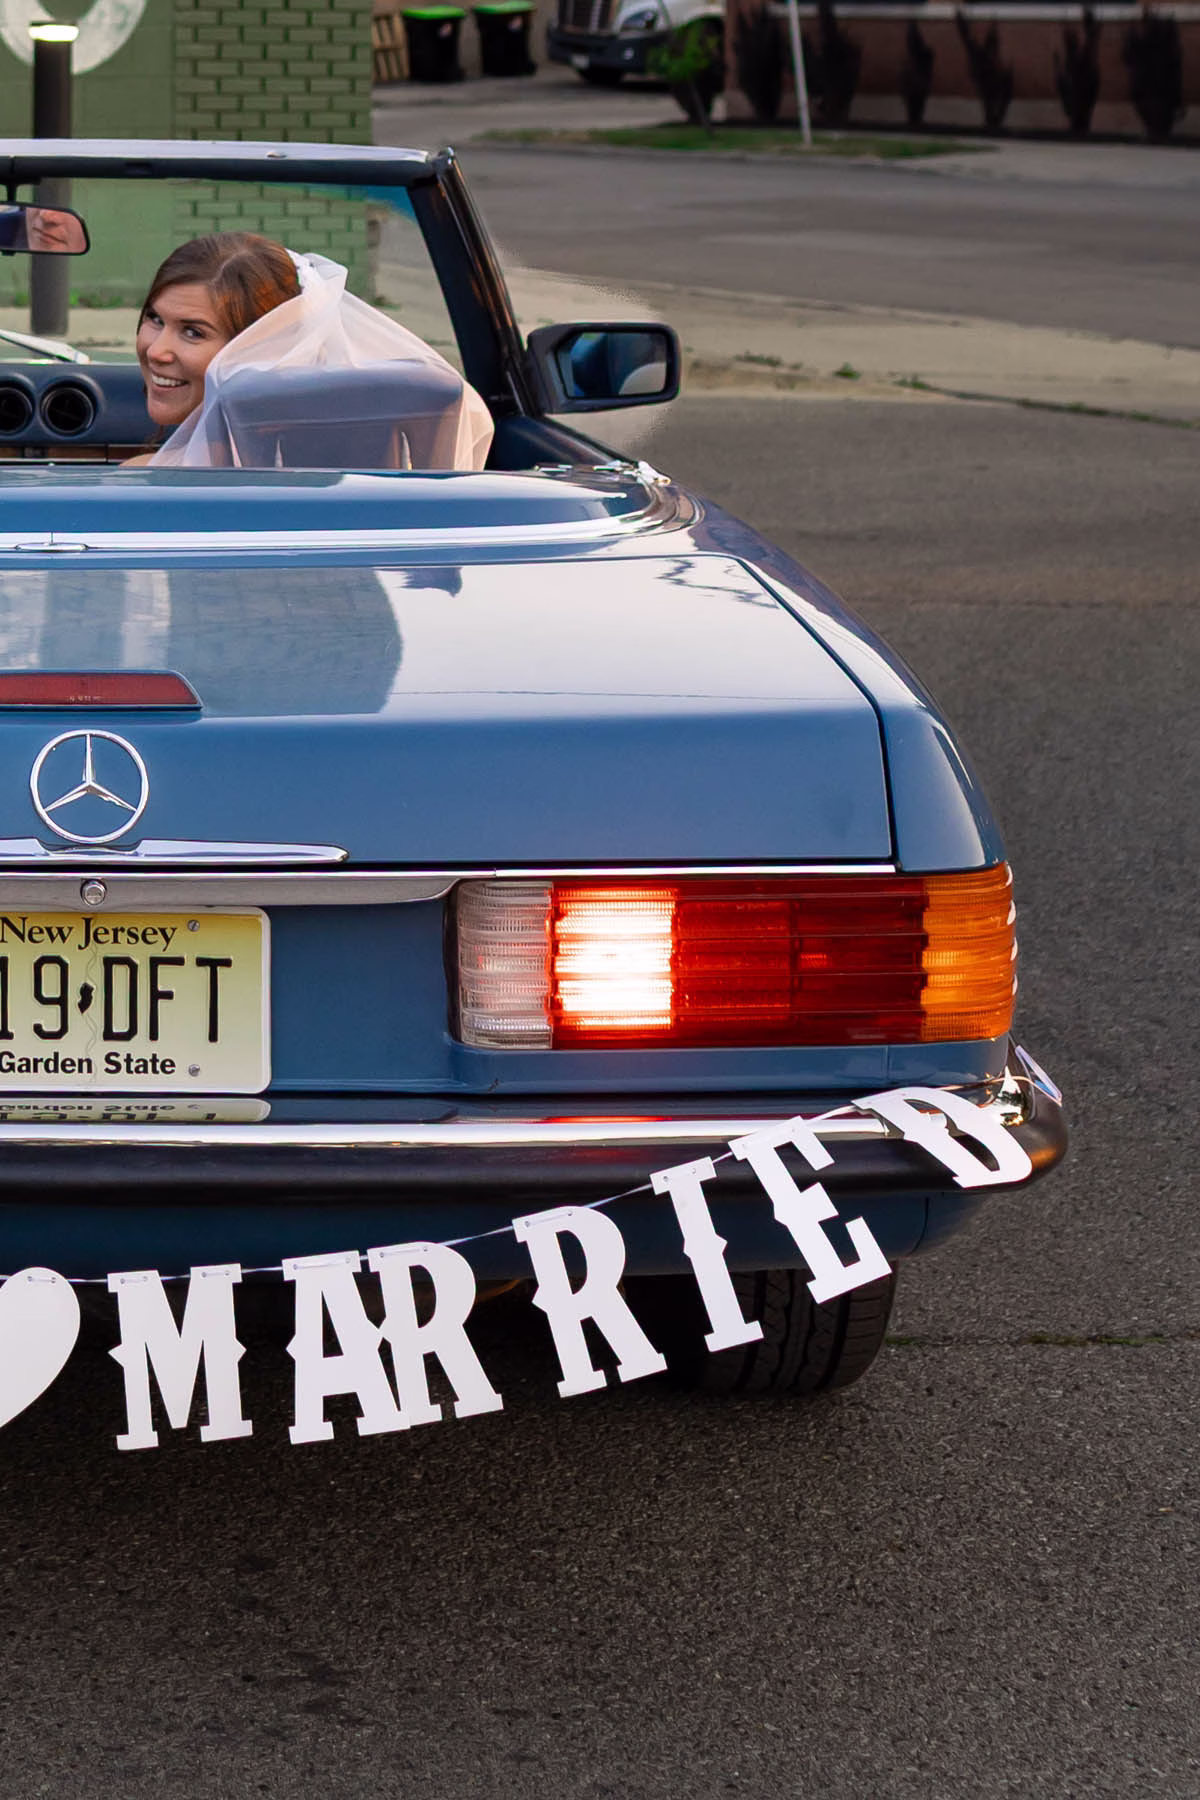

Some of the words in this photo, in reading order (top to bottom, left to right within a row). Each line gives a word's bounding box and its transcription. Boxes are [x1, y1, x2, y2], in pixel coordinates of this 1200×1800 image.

[76, 916, 178, 952] Jersey
[103, 1050, 177, 1076] State
[107, 1086, 1033, 1451] MARRIED
